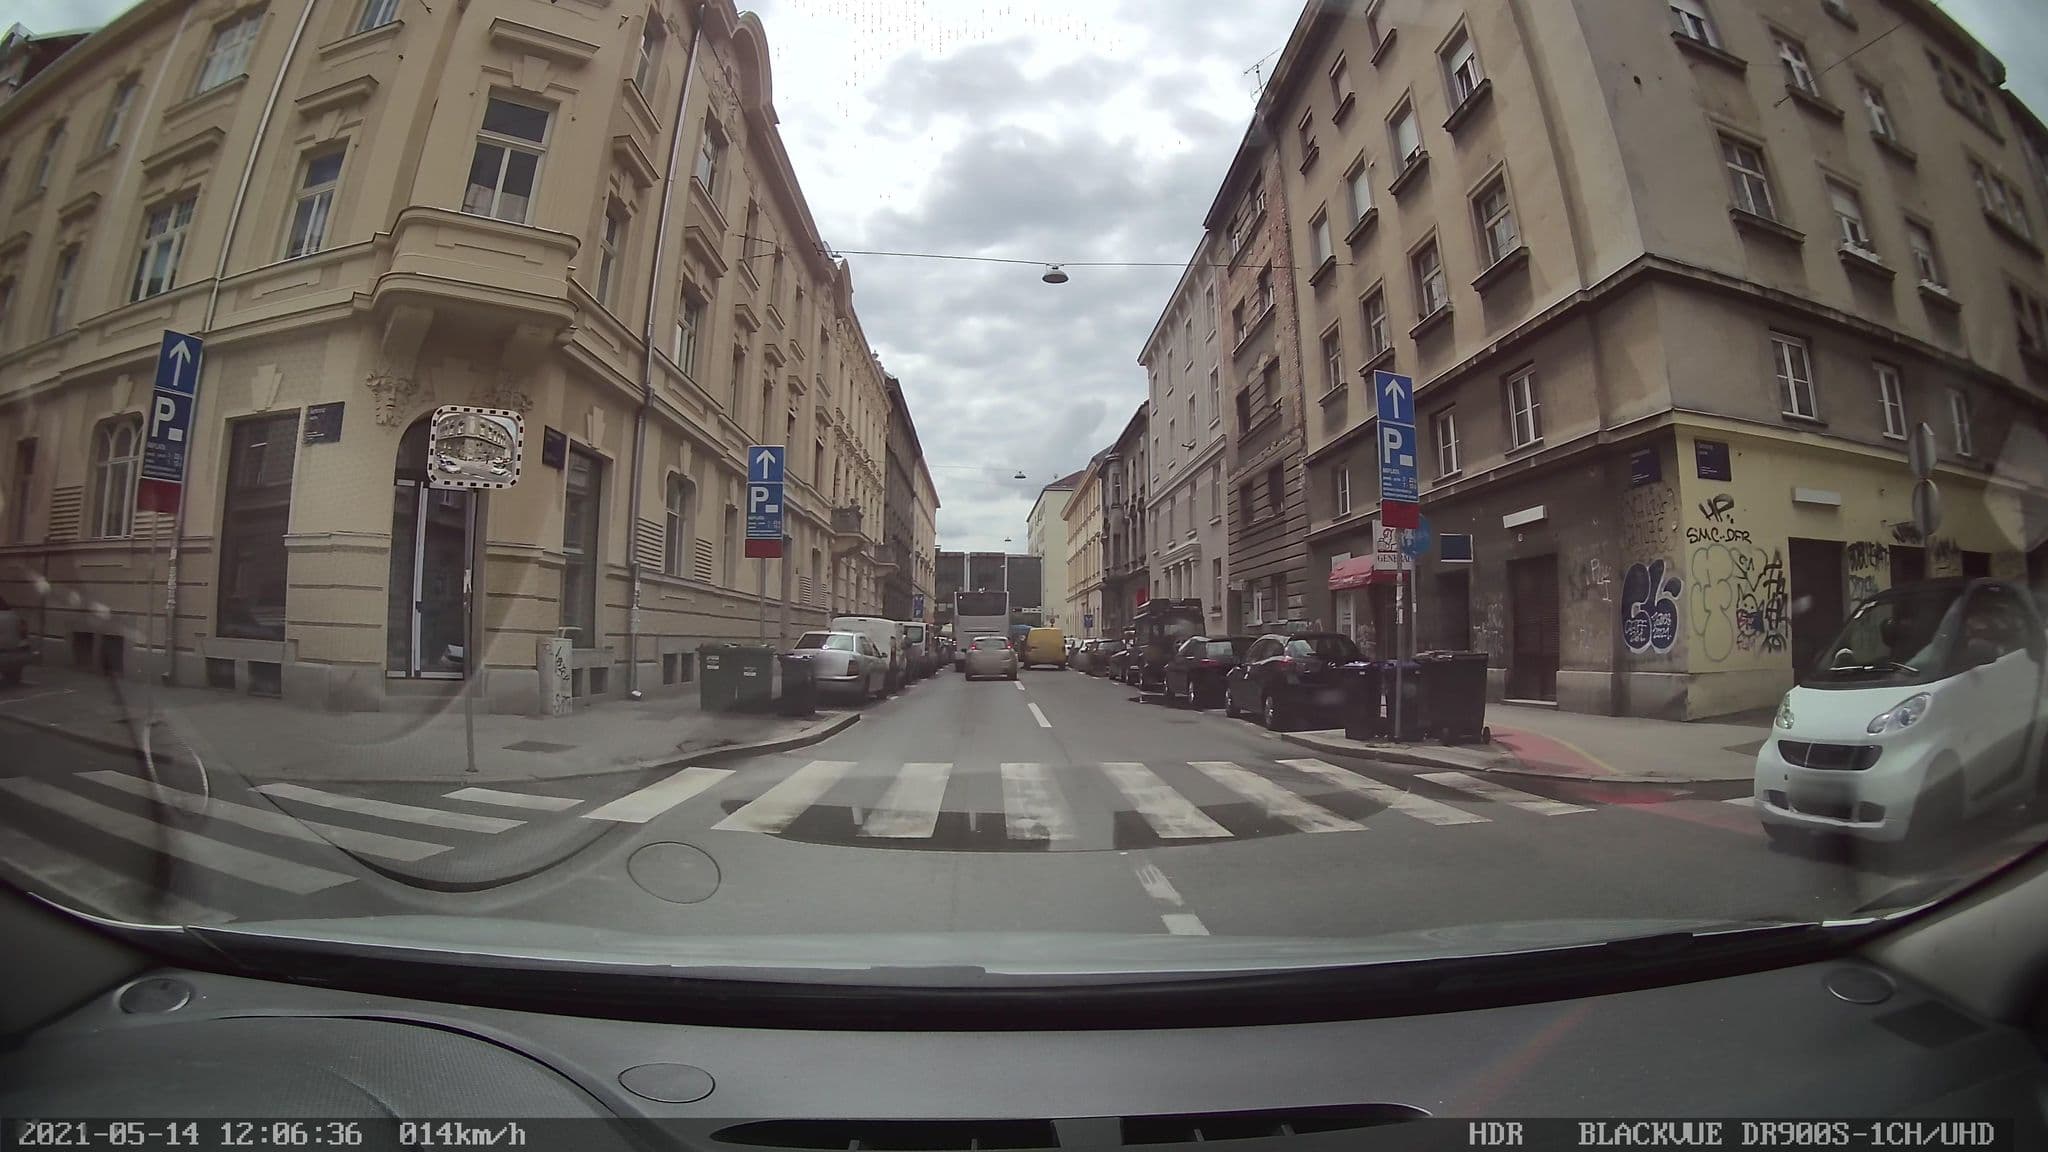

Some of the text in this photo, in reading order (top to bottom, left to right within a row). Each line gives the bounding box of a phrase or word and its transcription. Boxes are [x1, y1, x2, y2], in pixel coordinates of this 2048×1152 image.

[152, 396, 176, 437] P
[1383, 427, 1402, 464] P
[751, 486, 769, 513] P
